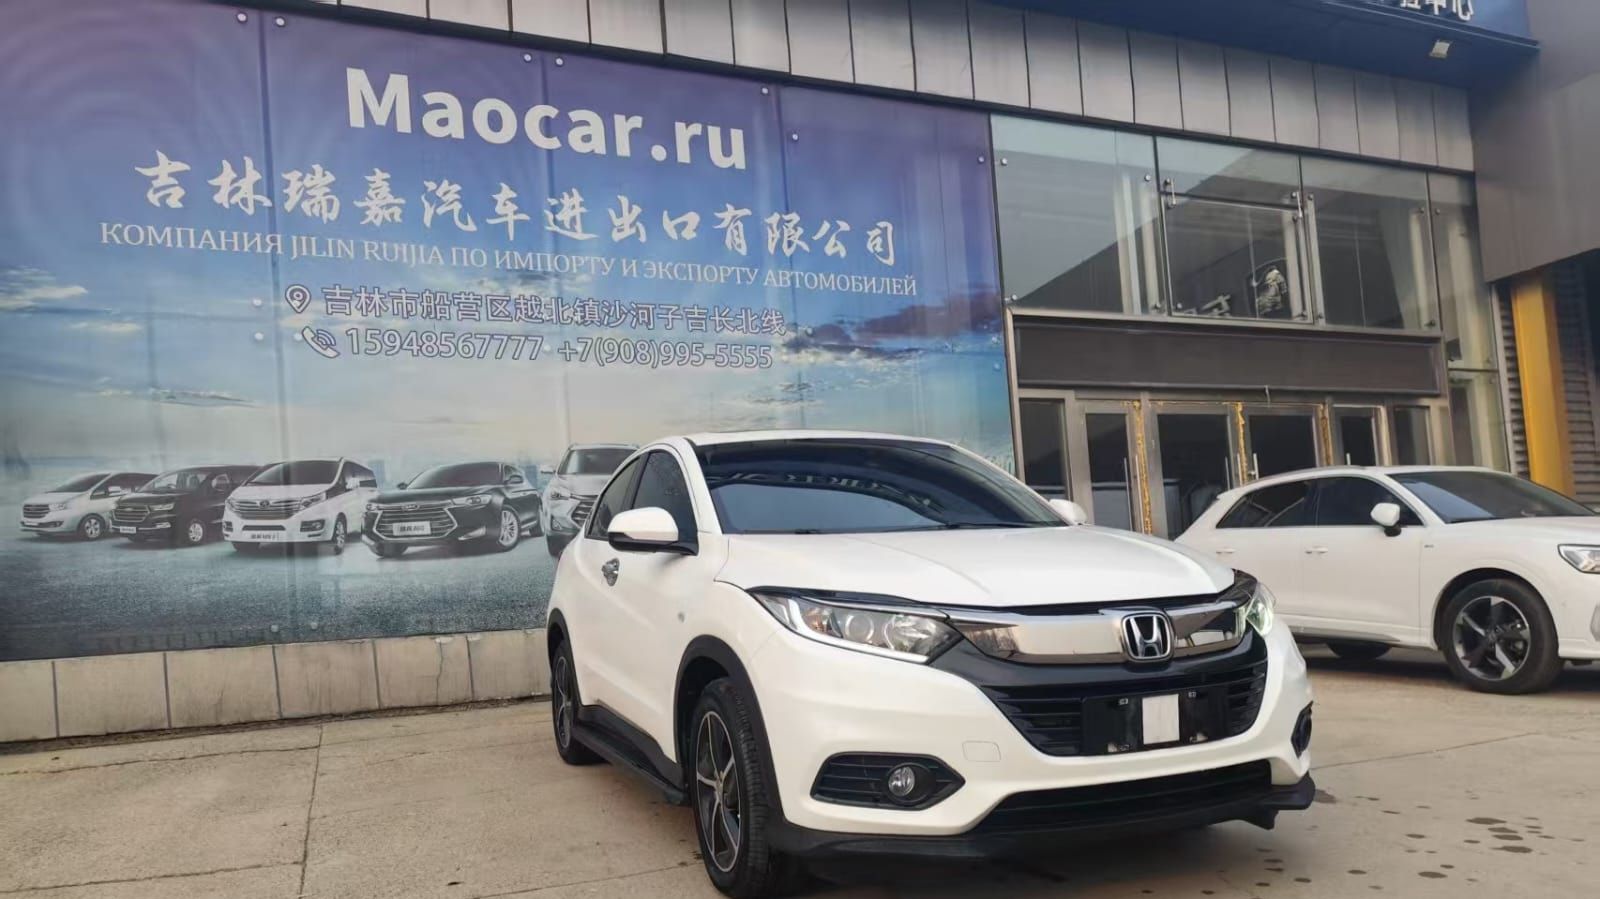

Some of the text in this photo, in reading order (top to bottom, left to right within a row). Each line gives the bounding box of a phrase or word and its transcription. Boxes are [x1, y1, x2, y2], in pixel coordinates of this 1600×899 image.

[346, 67, 747, 170] Maocar.ru
[134, 150, 897, 267] 吉林瑞嘉汽车进出口有限公司
[100, 222, 917, 296] КОМПАНИЯ JILIN RUIJIA ПО ИМПОРТУ И ЭКСПОРТУ АВТОМОБИЛЕЙ
[321, 284, 787, 336] 吉林市船营区越北镇沙河子吉长北线
[346, 327, 774, 369] 15948567777 +7(908)995-5555
